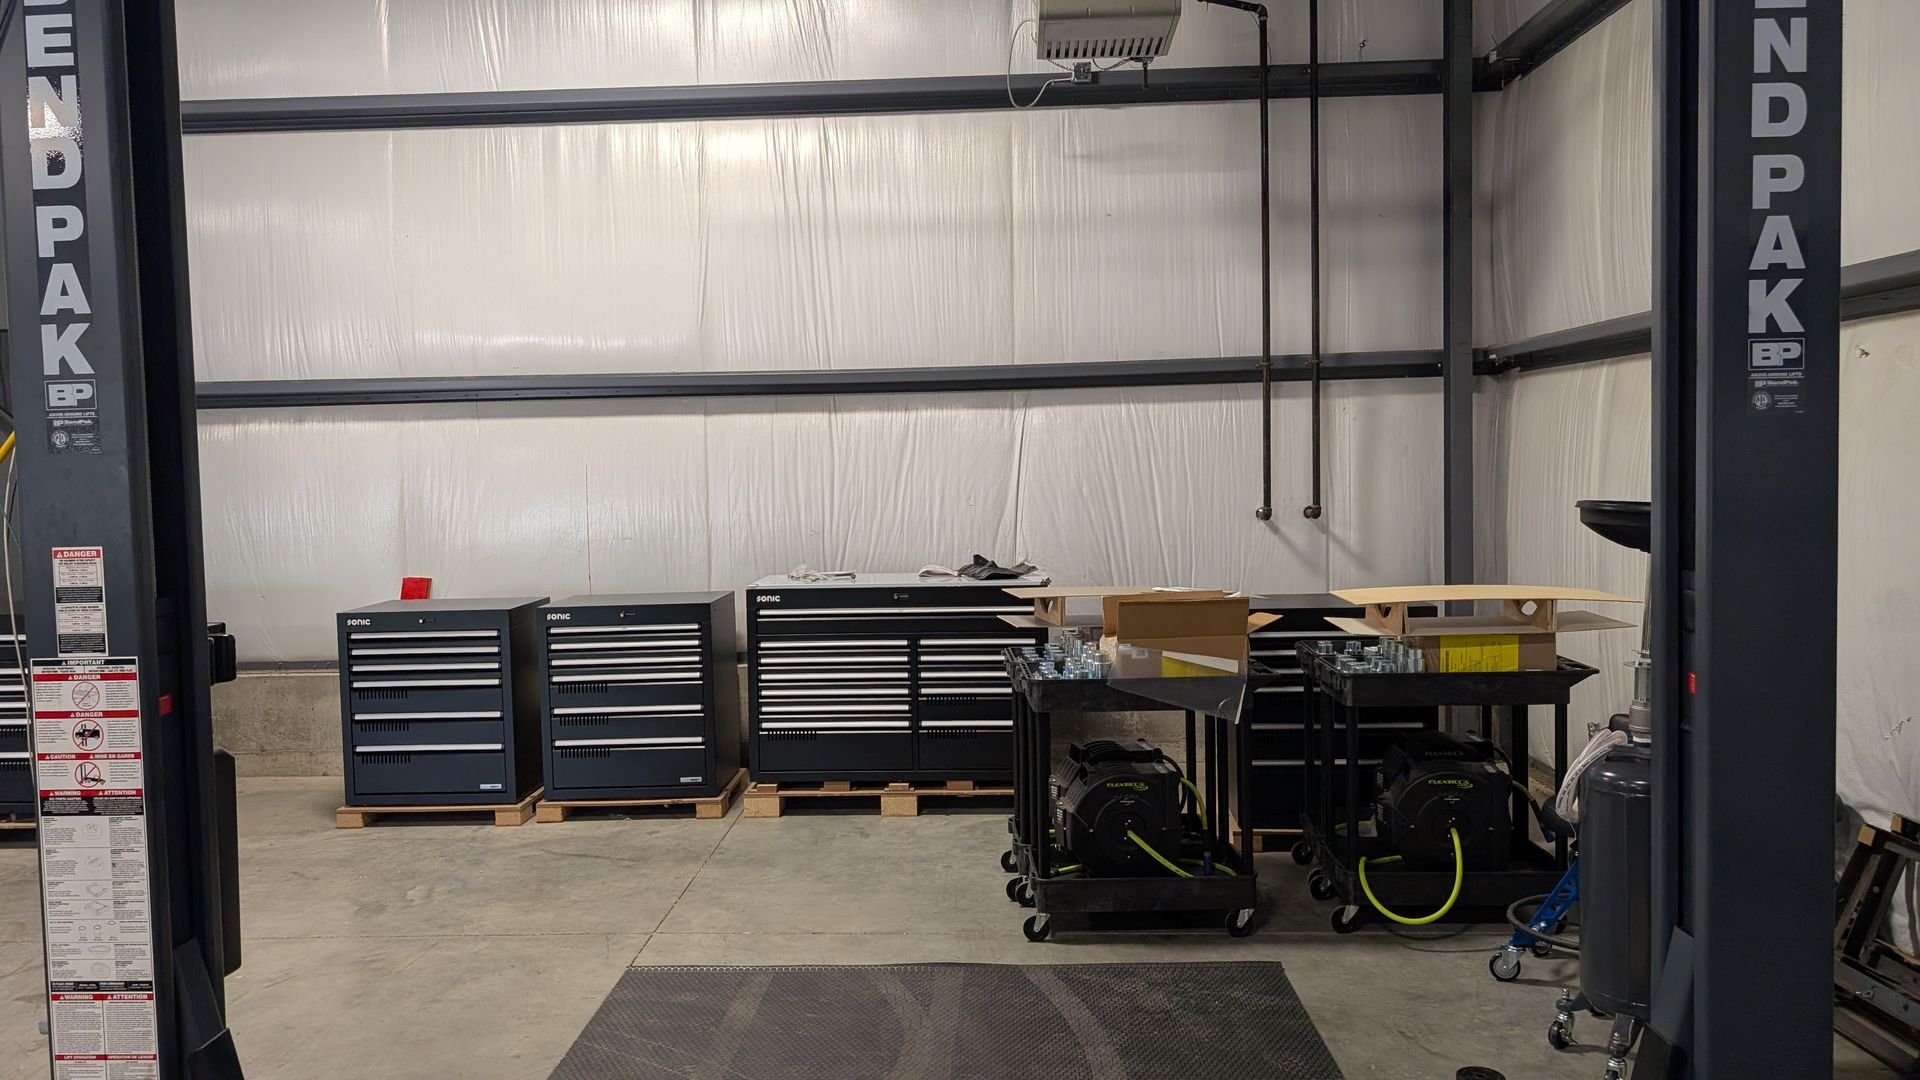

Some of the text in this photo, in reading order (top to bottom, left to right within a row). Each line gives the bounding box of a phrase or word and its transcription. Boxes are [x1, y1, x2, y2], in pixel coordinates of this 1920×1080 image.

[24, 0, 95, 376] ENDPAK
[1752, 342, 1802, 367] BP
[48, 383, 93, 407] BP
[63, 550, 97, 558] DANGER
